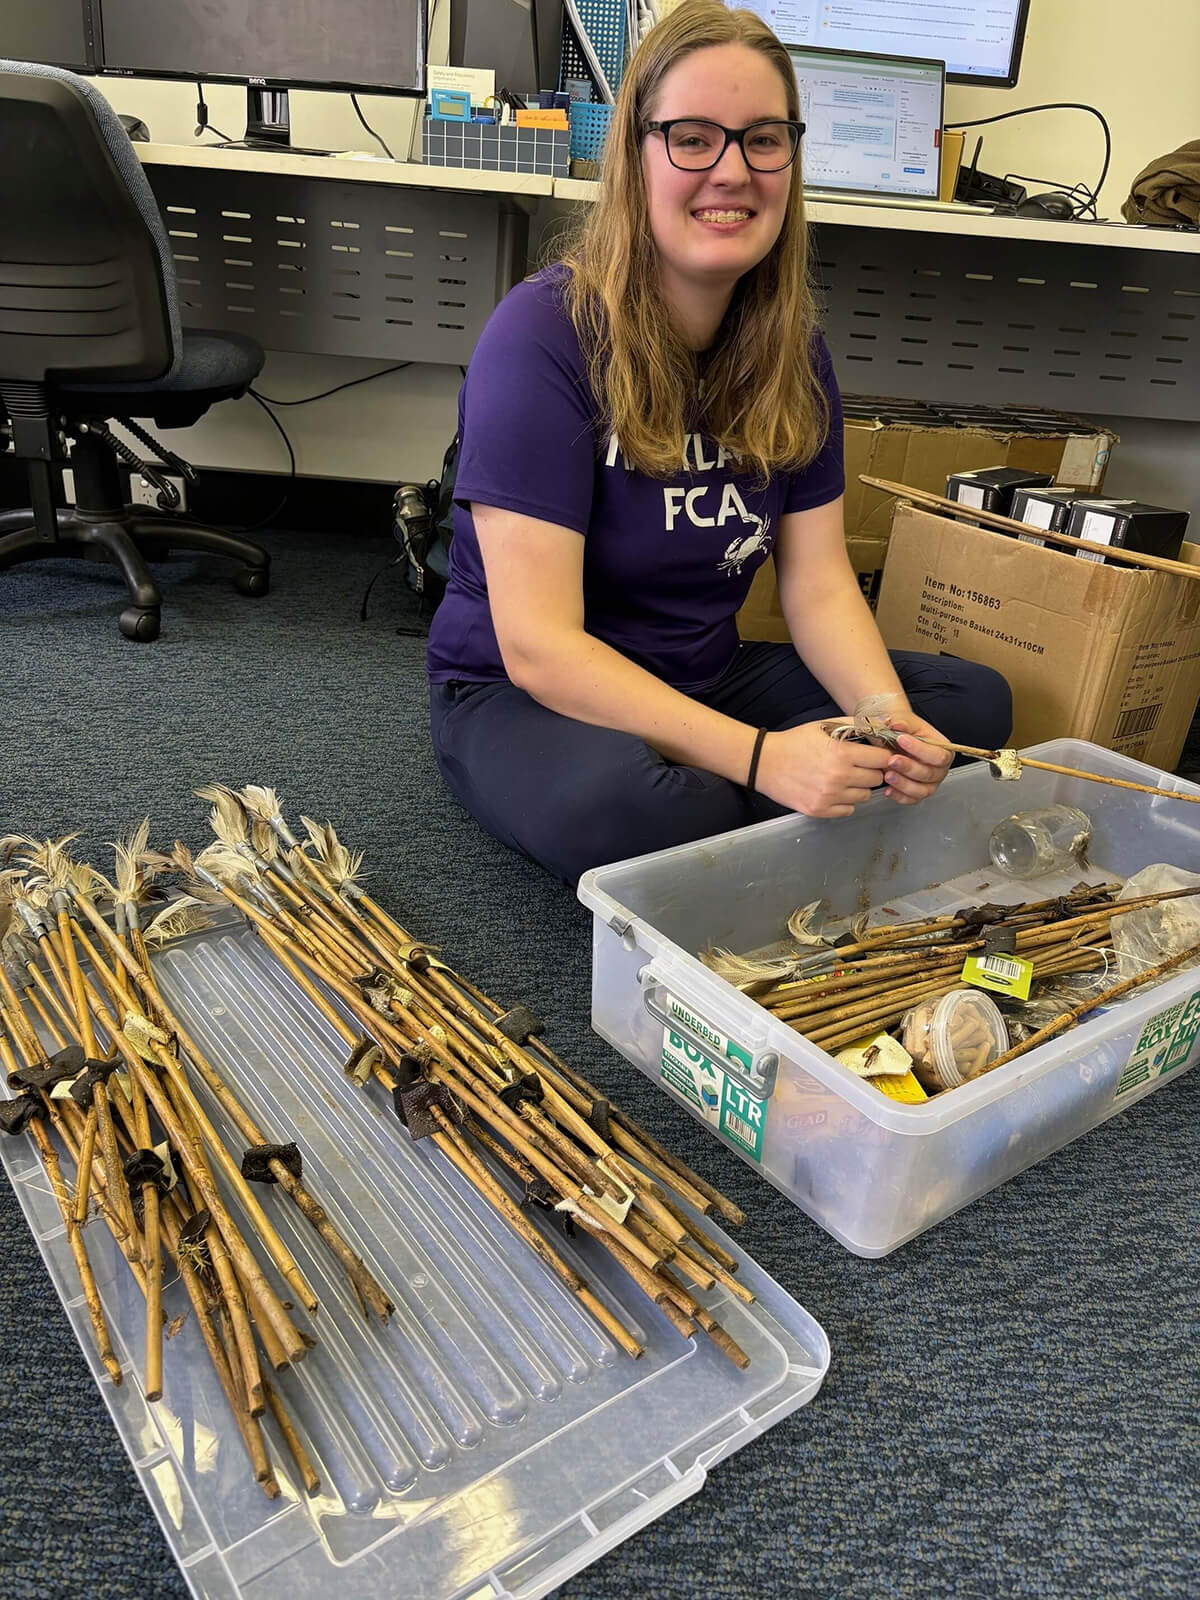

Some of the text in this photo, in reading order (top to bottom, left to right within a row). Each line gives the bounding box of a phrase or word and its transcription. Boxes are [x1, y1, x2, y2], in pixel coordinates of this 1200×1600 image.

[663, 483, 750, 531] FCA
[922, 590, 964, 612] Description:
[924, 576, 945, 591] Item
[969, 620, 994, 637] Basket
[995, 630, 1045, 656] 24x31x10CM
[671, 1001, 721, 1046] UNDERBED
[1134, 1021, 1177, 1056] BOX
[726, 1082, 762, 1127] LTR
